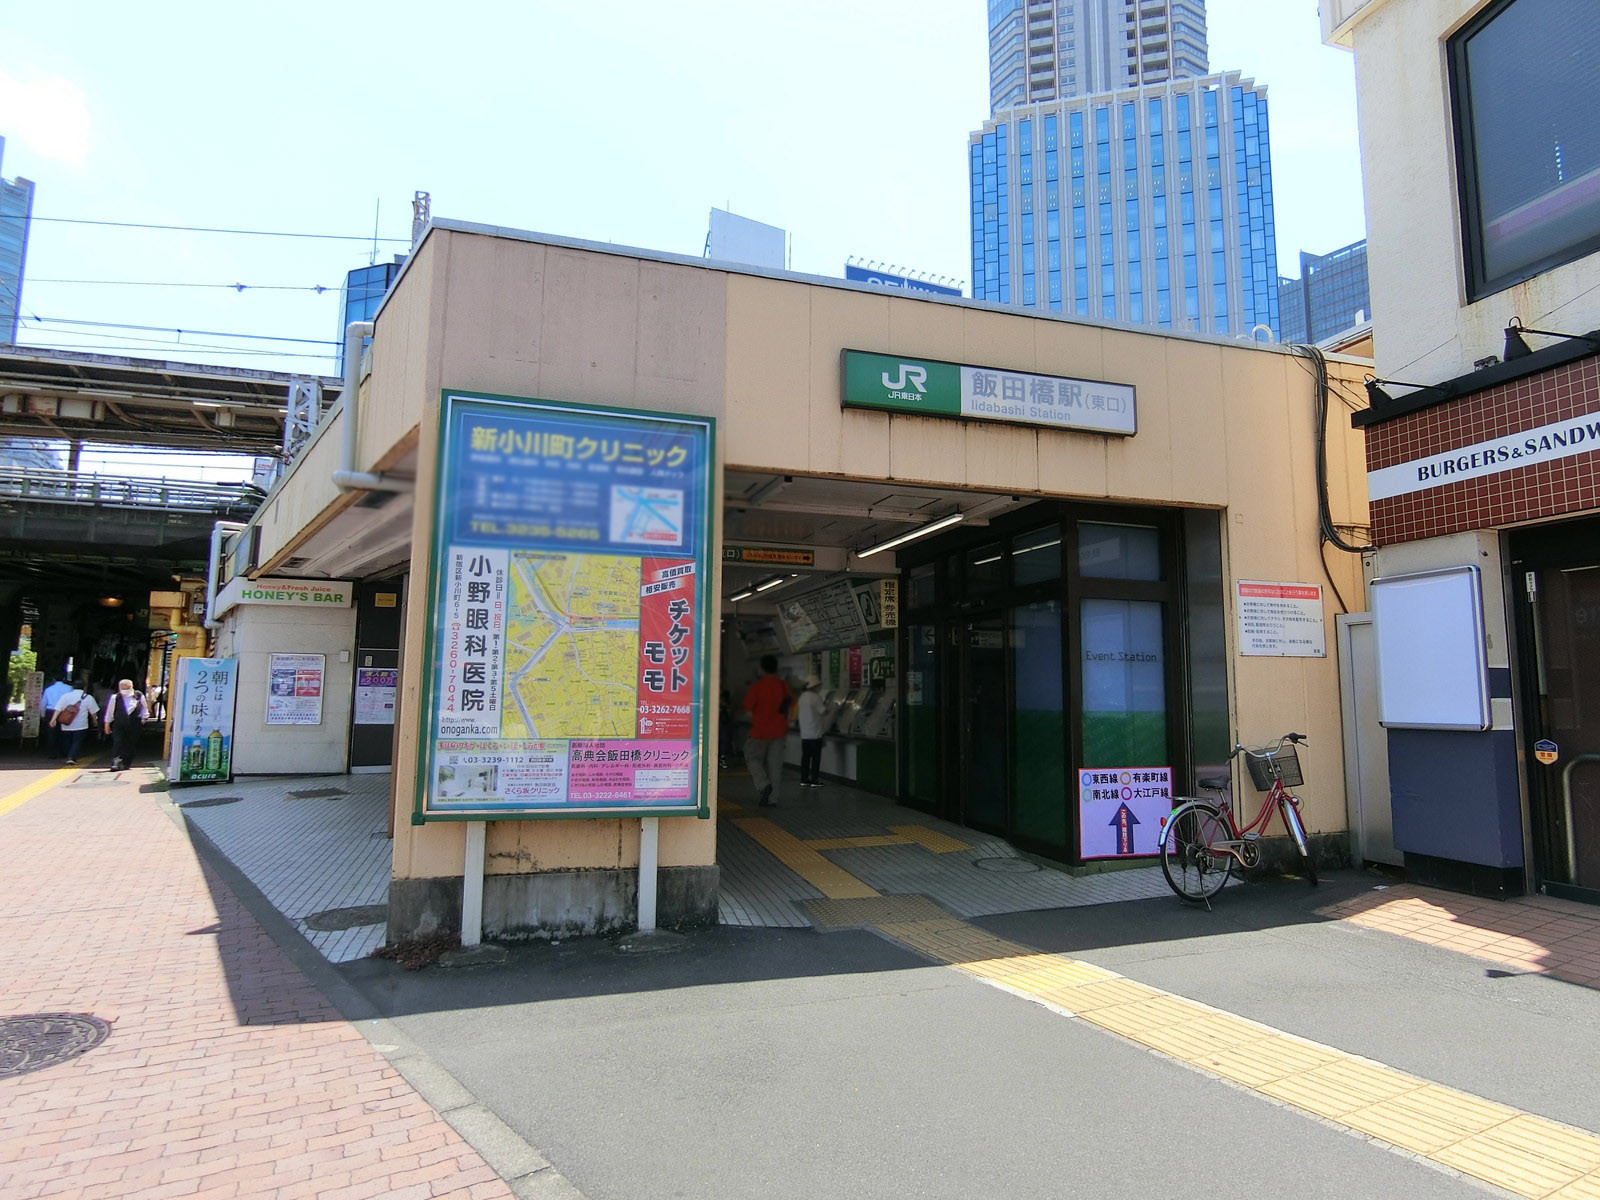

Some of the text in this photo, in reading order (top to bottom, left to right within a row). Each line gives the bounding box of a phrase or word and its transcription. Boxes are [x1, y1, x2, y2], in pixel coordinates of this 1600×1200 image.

[882, 364, 928, 393] JR
[888, 391, 923, 402] JR東日本
[971, 399, 1071, 422] Iidabashi Station
[470, 425, 688, 467] 新小川町クリニック
[661, 565, 692, 579] 高価買取
[256, 583, 332, 592] Honey&Fresh Juice
[645, 580, 676, 594] 格安販売
[241, 590, 344, 603] HONEY'S BAR
[461, 554, 493, 712] 小野眼科医院
[667, 598, 691, 693] チケット
[1085, 651, 1157, 662] Event Station
[446, 631, 460, 712] 3260-7044
[643, 641, 667, 693] モモ
[211, 669, 229, 701] 朝には
[191, 669, 210, 738] 2つの味がある
[639, 705, 691, 714] 03-3262-7668
[440, 724, 498, 736] onoganka.com
[467, 756, 525, 764] 03-3239-1112
[571, 749, 689, 762] 高典会飯田橋クリニック
[191, 772, 217, 780] acure
[1091, 773, 1119, 785] 東西線
[1132, 772, 1169, 783] 有楽町線
[1092, 789, 1120, 801] 南北線
[1133, 787, 1169, 798] 大江戸線
